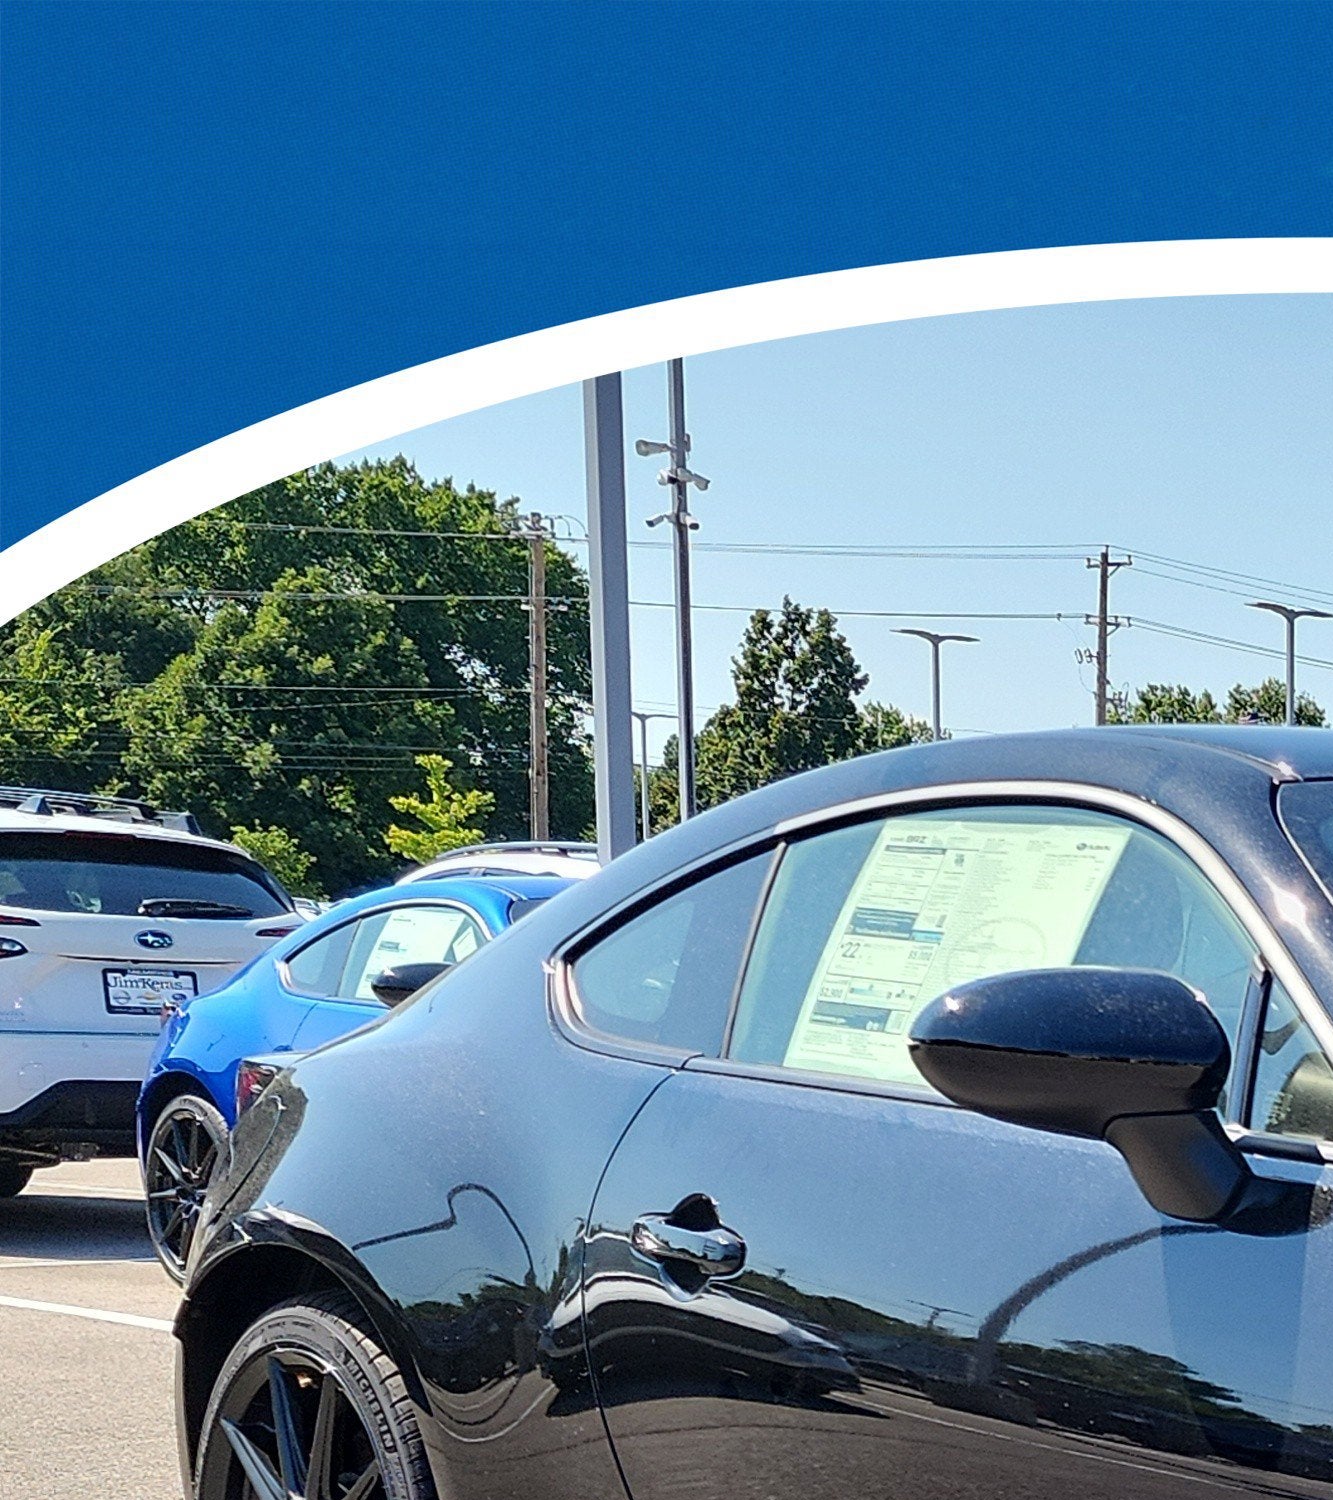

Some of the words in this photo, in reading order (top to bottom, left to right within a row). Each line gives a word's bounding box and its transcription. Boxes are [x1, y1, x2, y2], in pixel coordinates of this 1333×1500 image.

[107, 976, 139, 988] Jim
[139, 977, 182, 992] Keras
[348, 1359, 394, 1448] MICHELIN
